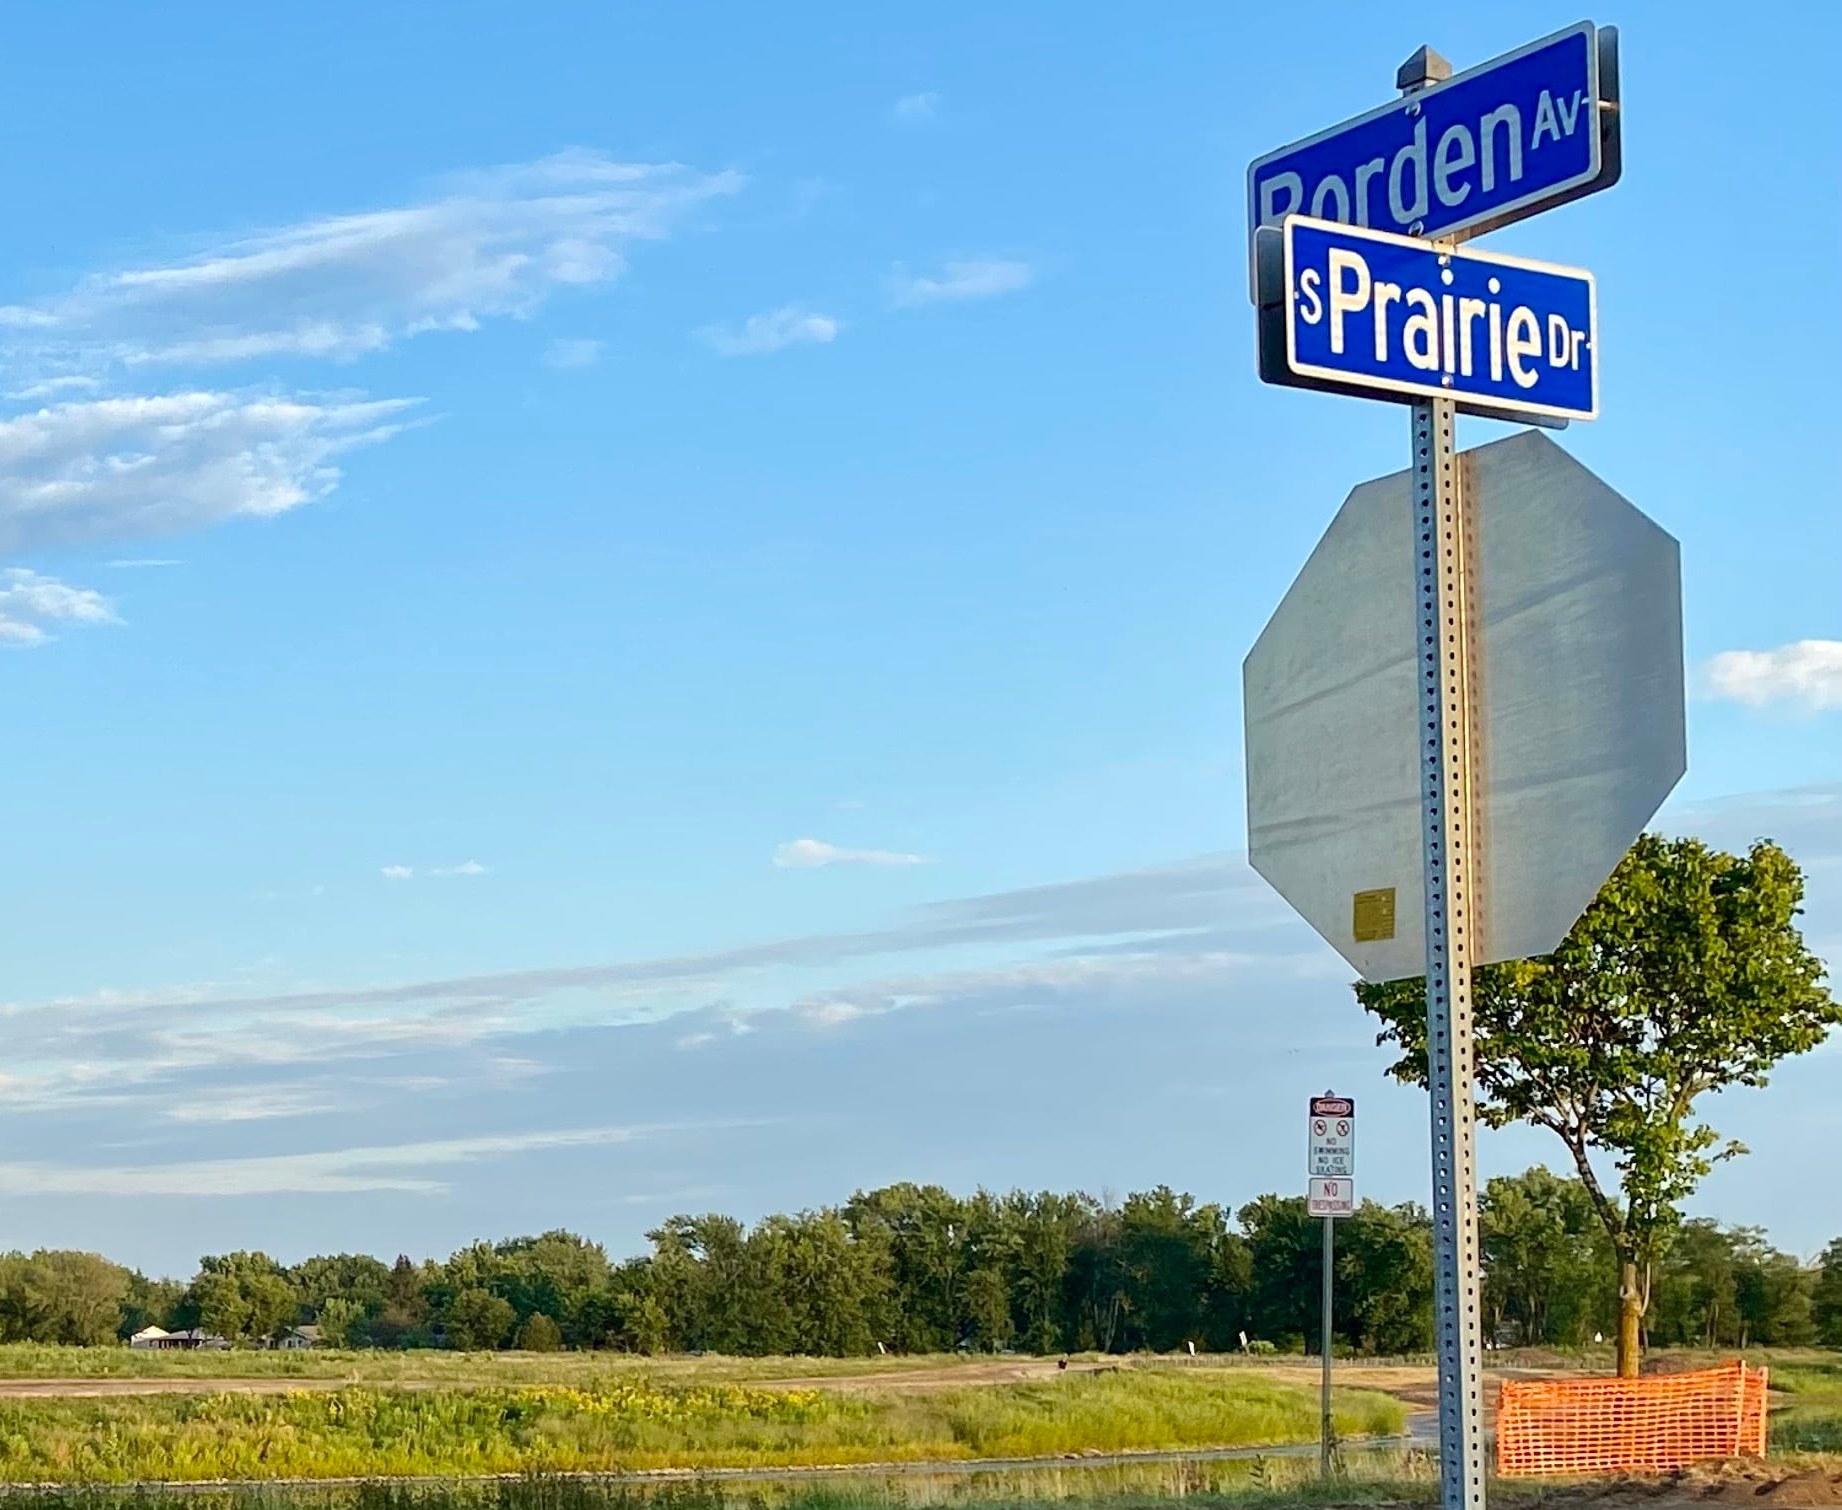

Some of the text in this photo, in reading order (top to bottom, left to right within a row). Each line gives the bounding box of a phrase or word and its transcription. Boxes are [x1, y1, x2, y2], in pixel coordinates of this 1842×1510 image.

[1531, 90, 1581, 150] Av
[1300, 247, 1585, 388] S Prairie Dr
[1324, 1182, 1338, 1197] NO
